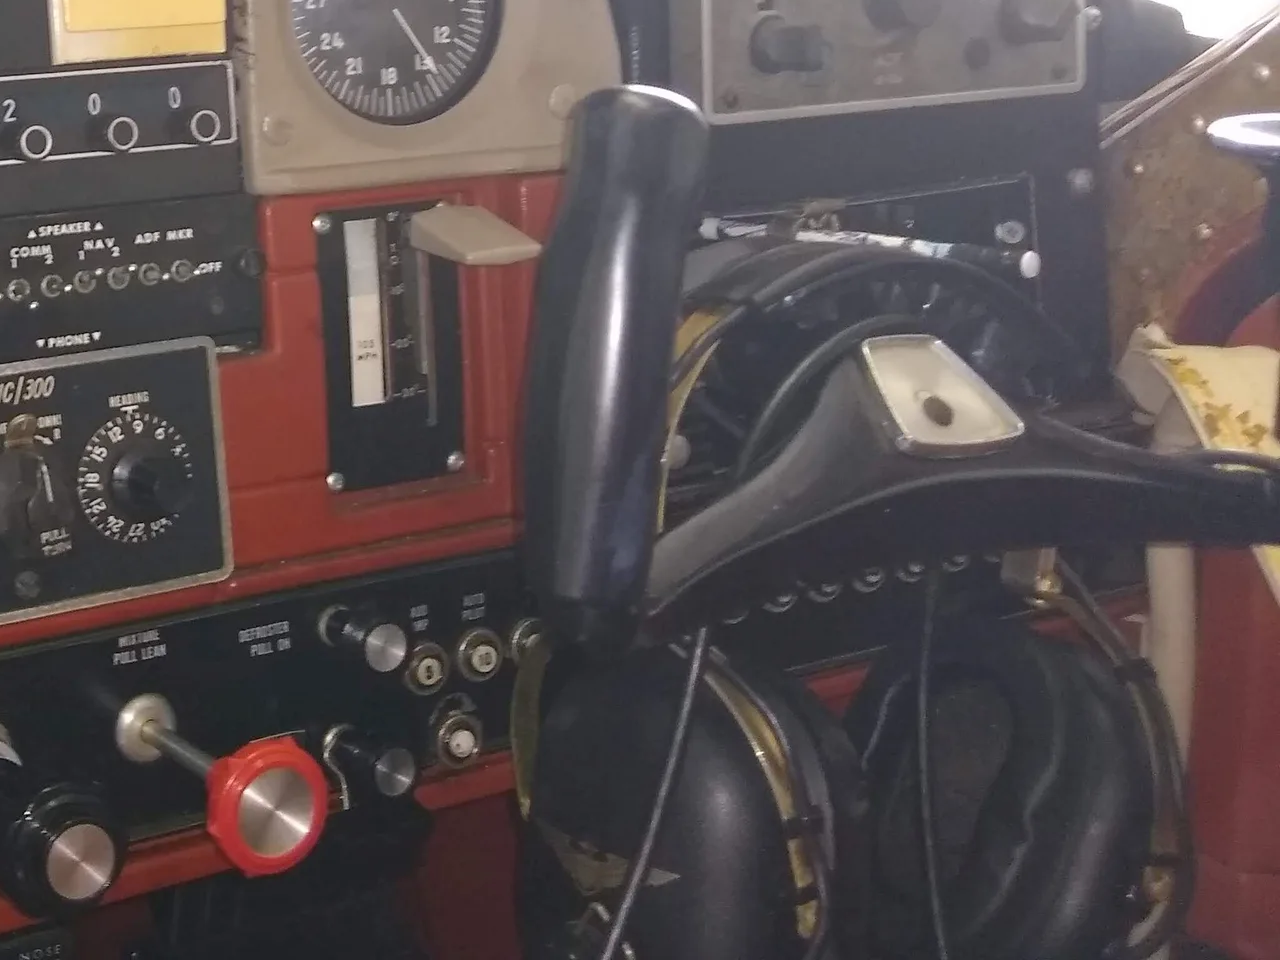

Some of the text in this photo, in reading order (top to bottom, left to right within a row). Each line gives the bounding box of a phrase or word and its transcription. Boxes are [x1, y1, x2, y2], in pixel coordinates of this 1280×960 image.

[320, 31, 346, 51] 24
[433, 25, 451, 44] 12
[345, 56, 364, 76] 21
[2, 98, 18, 123] 2
[87, 92, 102, 116] 0
[167, 86, 182, 109] 0
[38, 221, 93, 238] SPEAKER
[134, 227, 194, 245] ADF MKR
[9, 244, 53, 259] COMM
[82, 236, 116, 251] NAV
[10, 254, 55, 269] 1 2
[77, 246, 122, 262] 1 2
[196, 260, 223, 273] OFF
[47, 332, 92, 349] PHONE
[107, 390, 151, 409] HEADING
[106, 425, 126, 444] 12
[131, 419, 145, 435] 9
[153, 427, 167, 441] 6
[89, 444, 109, 463] 15
[88, 497, 108, 515] 21
[39, 527, 70, 544] PULL
[112, 649, 138, 666] PULL
[250, 641, 274, 658] PULL
